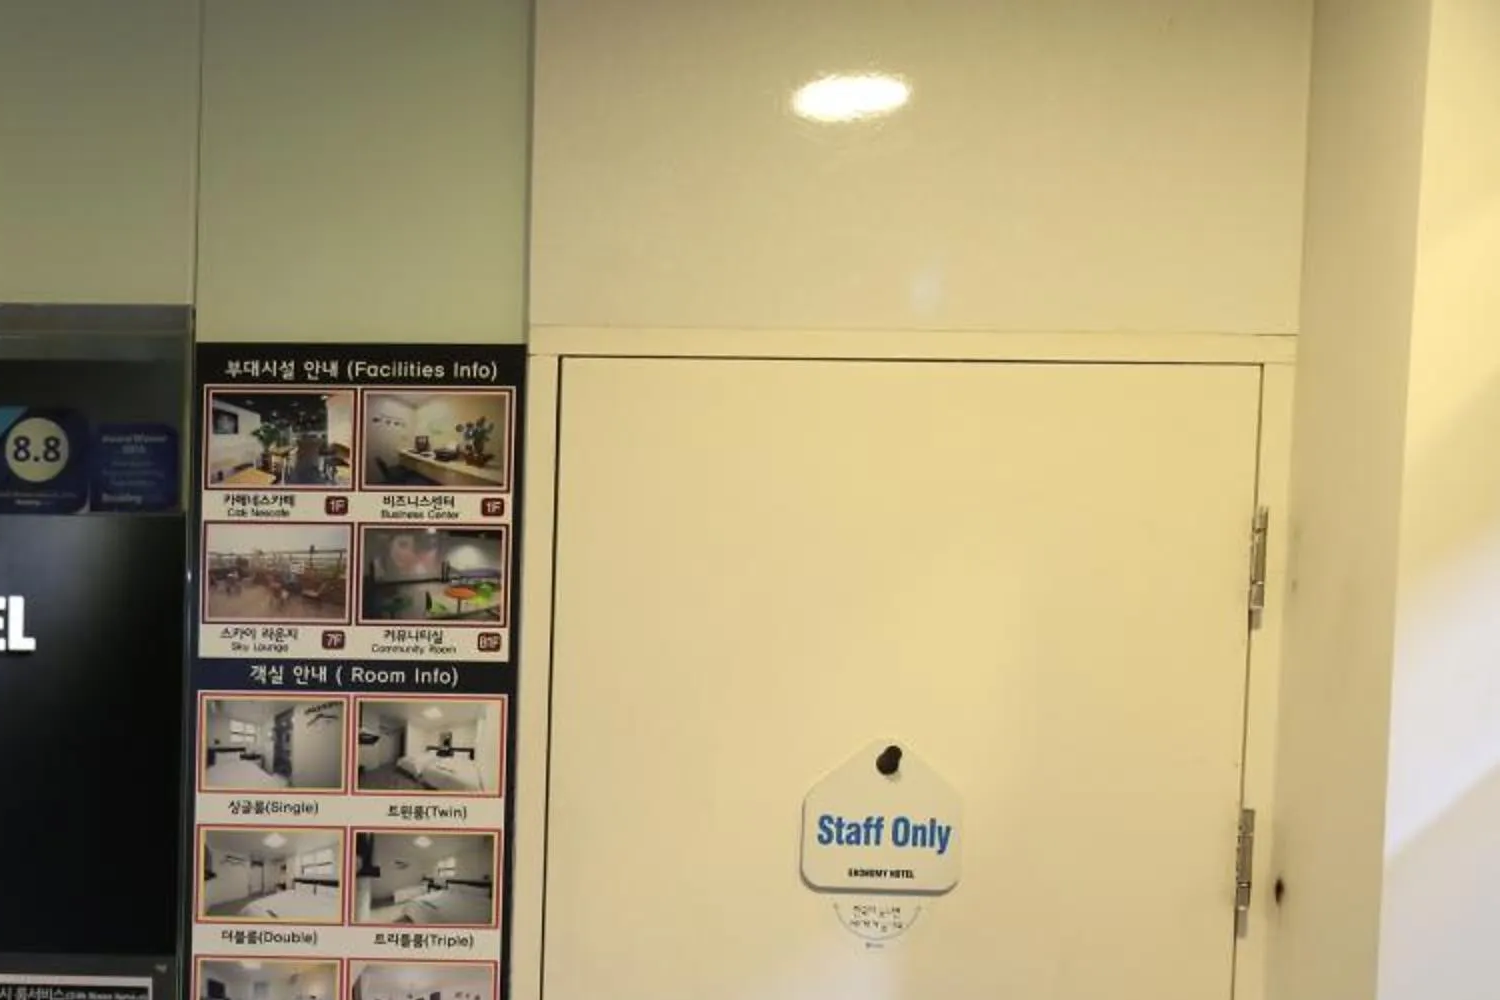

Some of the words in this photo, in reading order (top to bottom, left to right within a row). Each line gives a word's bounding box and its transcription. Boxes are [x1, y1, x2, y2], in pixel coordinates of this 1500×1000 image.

[224, 360, 296, 381] 부대시설
[303, 360, 340, 379] 안내
[347, 361, 446, 380] (Facilities
[453, 361, 498, 380] Info)
[13, 435, 61, 463] 8.8
[330, 498, 346, 513] 1F
[382, 495, 455, 510] 비즈니스센터
[485, 500, 501, 514] 1F
[220, 628, 256, 641] 스카이
[261, 628, 298, 641] 라운지
[326, 632, 343, 648] 7F
[249, 664, 284, 685] 객실
[293, 664, 328, 684] 안내
[351, 667, 406, 683] Room
[415, 667, 459, 686] Info)
[228, 801, 319, 818] 싱글룸(Single)
[388, 805, 468, 821] 트윈룸(Twin)
[817, 814, 885, 846] Staff
[892, 816, 952, 855] Only
[847, 867, 888, 879] EKONOMY
[889, 869, 915, 879] HOTEL
[221, 930, 318, 946] 더블룸(Double)
[373, 933, 475, 950] 트리플룸(Triple)
